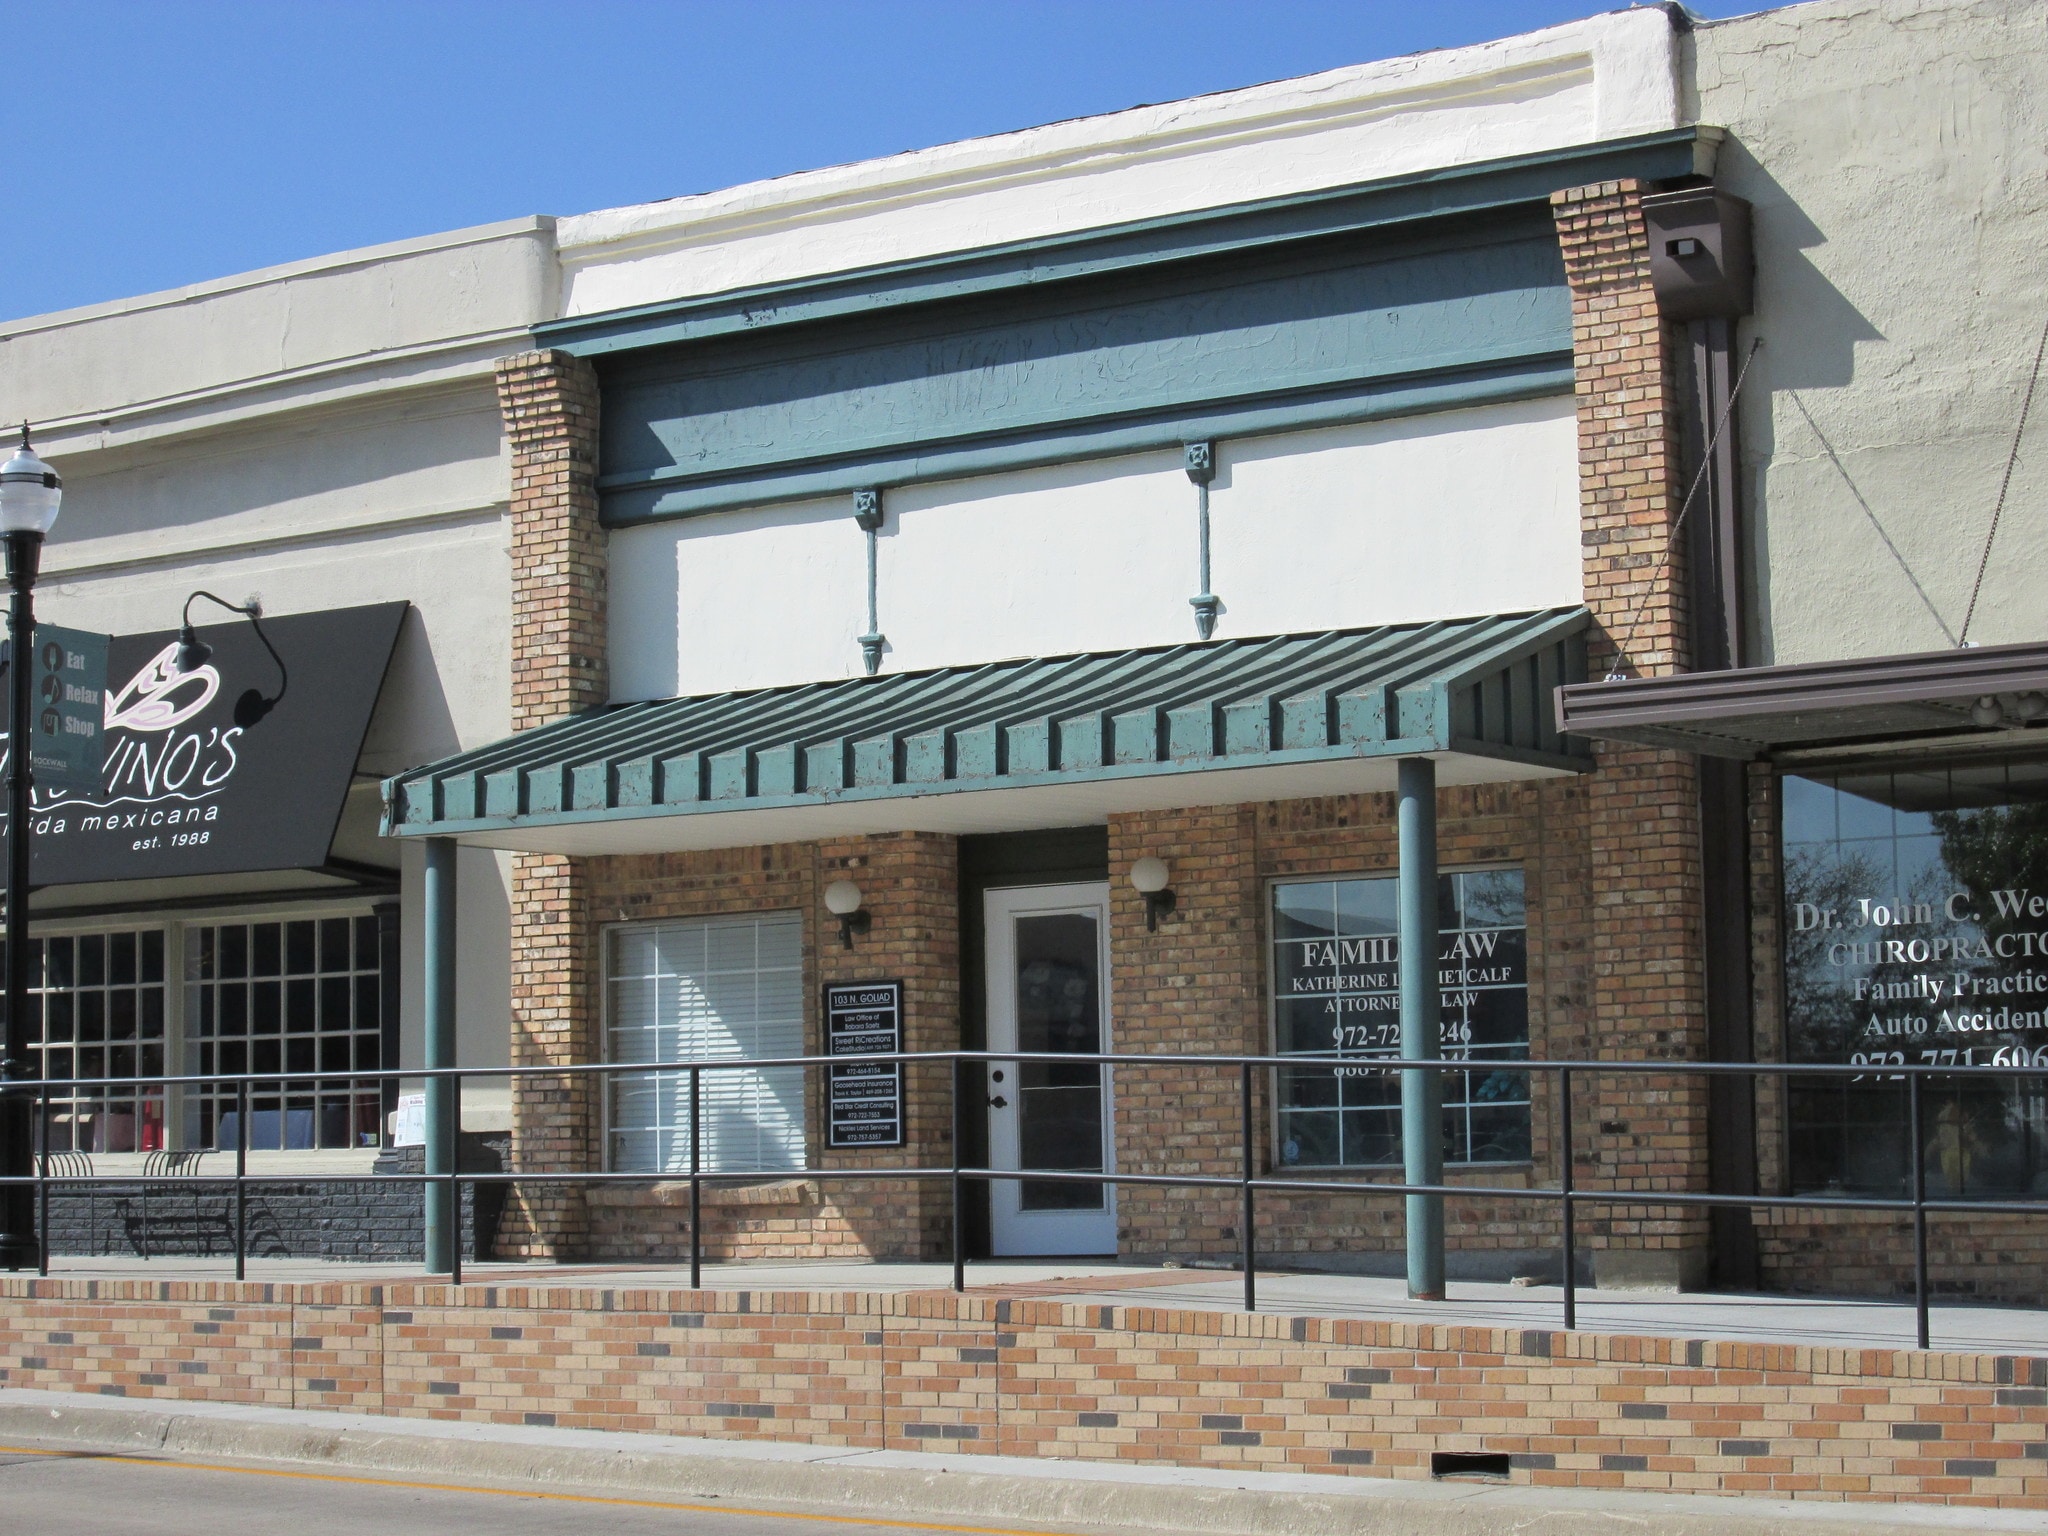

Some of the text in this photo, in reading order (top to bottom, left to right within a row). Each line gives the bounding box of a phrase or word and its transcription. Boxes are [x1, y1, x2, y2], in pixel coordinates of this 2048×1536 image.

[66, 651, 84, 670] Eat
[66, 684, 98, 705] Relax
[65, 716, 94, 738] Shop
[81, 804, 218, 831] mexicana
[132, 831, 210, 850] est. 1988
[1794, 902, 1843, 931] Dr.
[1853, 897, 1932, 928] John
[1944, 892, 1980, 922] C.
[1302, 937, 1399, 968] FAMIL
[1292, 973, 1388, 992] KATHERINE
[1853, 968, 2048, 1004] Family Practic
[834, 995, 847, 1005] 103
[860, 993, 890, 1003] GOLIAD
[1325, 992, 1479, 1013] ATTORNE LAW
[856, 1014, 873, 1022] Office
[1864, 1012, 1928, 1037] Auto
[835, 1037, 854, 1045] Sweet
